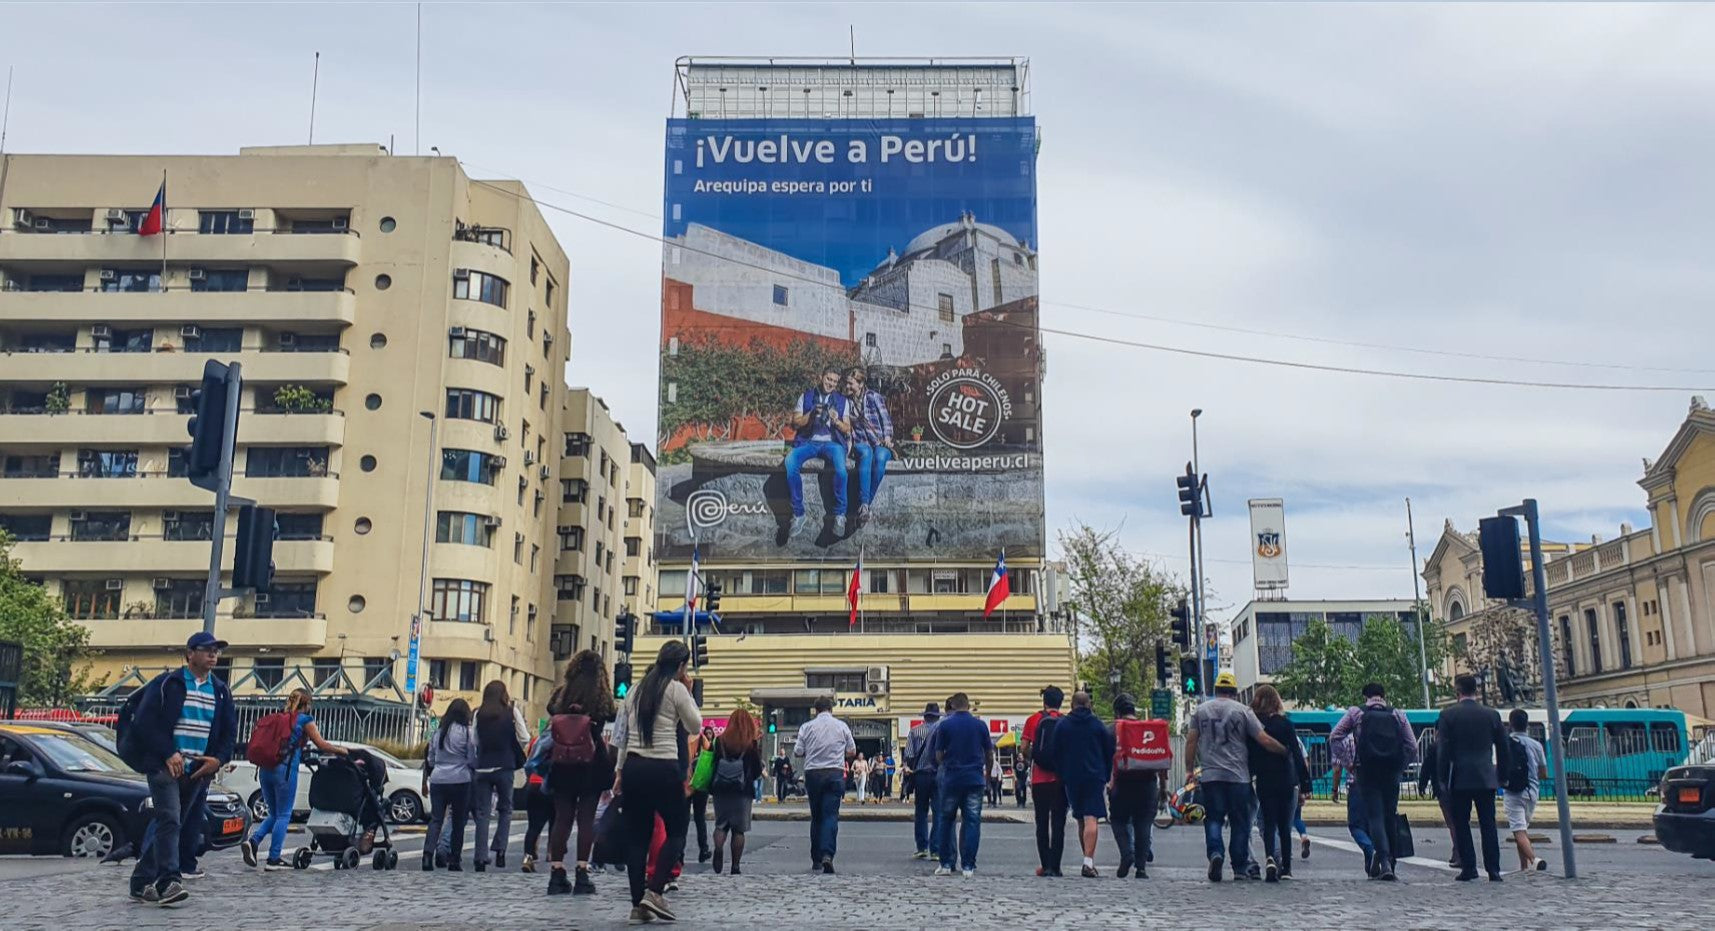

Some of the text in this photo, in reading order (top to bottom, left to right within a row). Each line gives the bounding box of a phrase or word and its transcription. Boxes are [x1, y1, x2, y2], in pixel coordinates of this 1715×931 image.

[696, 133, 977, 168] ¡Vuelve a Perú!
[694, 178, 872, 194] Arequipa espera por ti
[947, 391, 989, 416] HOT
[952, 368, 980, 379] PARA
[981, 373, 1012, 417] CHILENOS
[938, 407, 987, 435] SALE
[903, 455, 1029, 471] vuelveaperu.cl
[832, 698, 876, 707] TARIA
